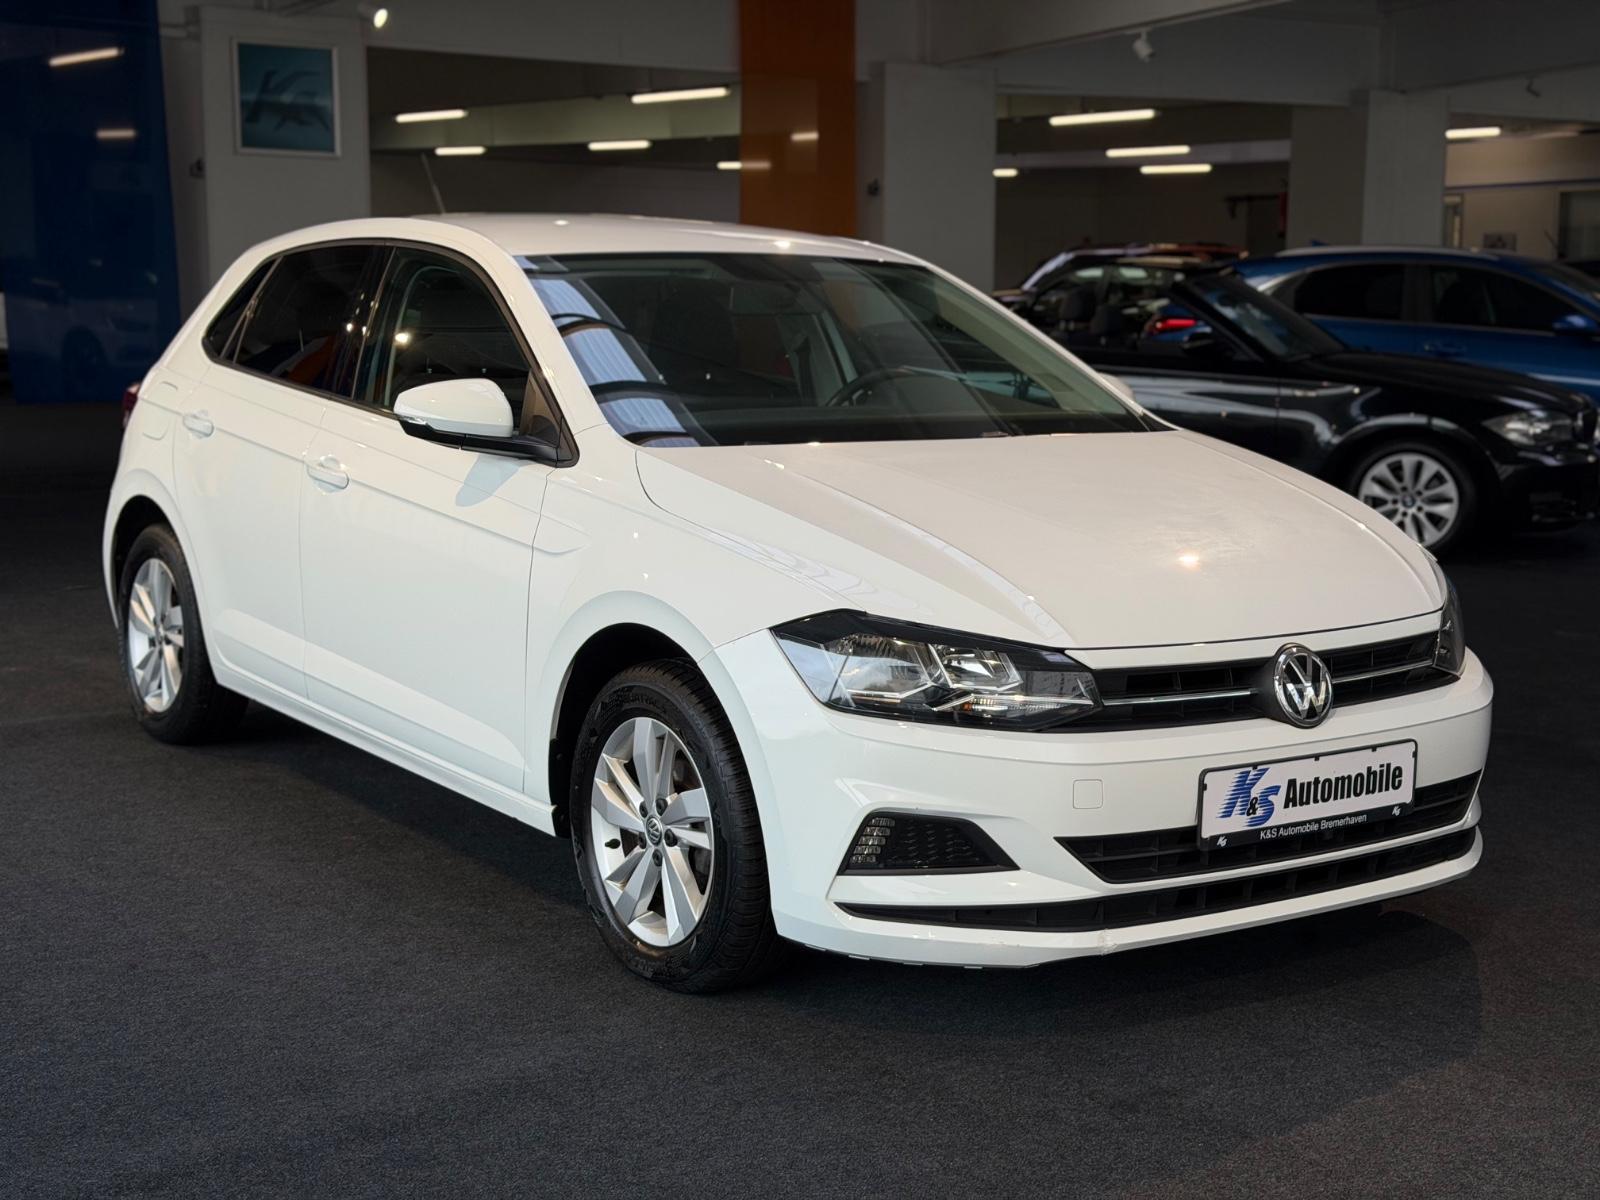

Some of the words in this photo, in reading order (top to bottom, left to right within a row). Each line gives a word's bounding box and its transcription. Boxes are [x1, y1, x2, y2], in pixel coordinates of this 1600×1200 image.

[1216, 767, 1282, 828] K&S
[1283, 762, 1404, 809] Automobile
[1260, 827, 1277, 840] K&S
[1278, 820, 1319, 836] Automobile
[1320, 813, 1368, 830] Bremerhaven
